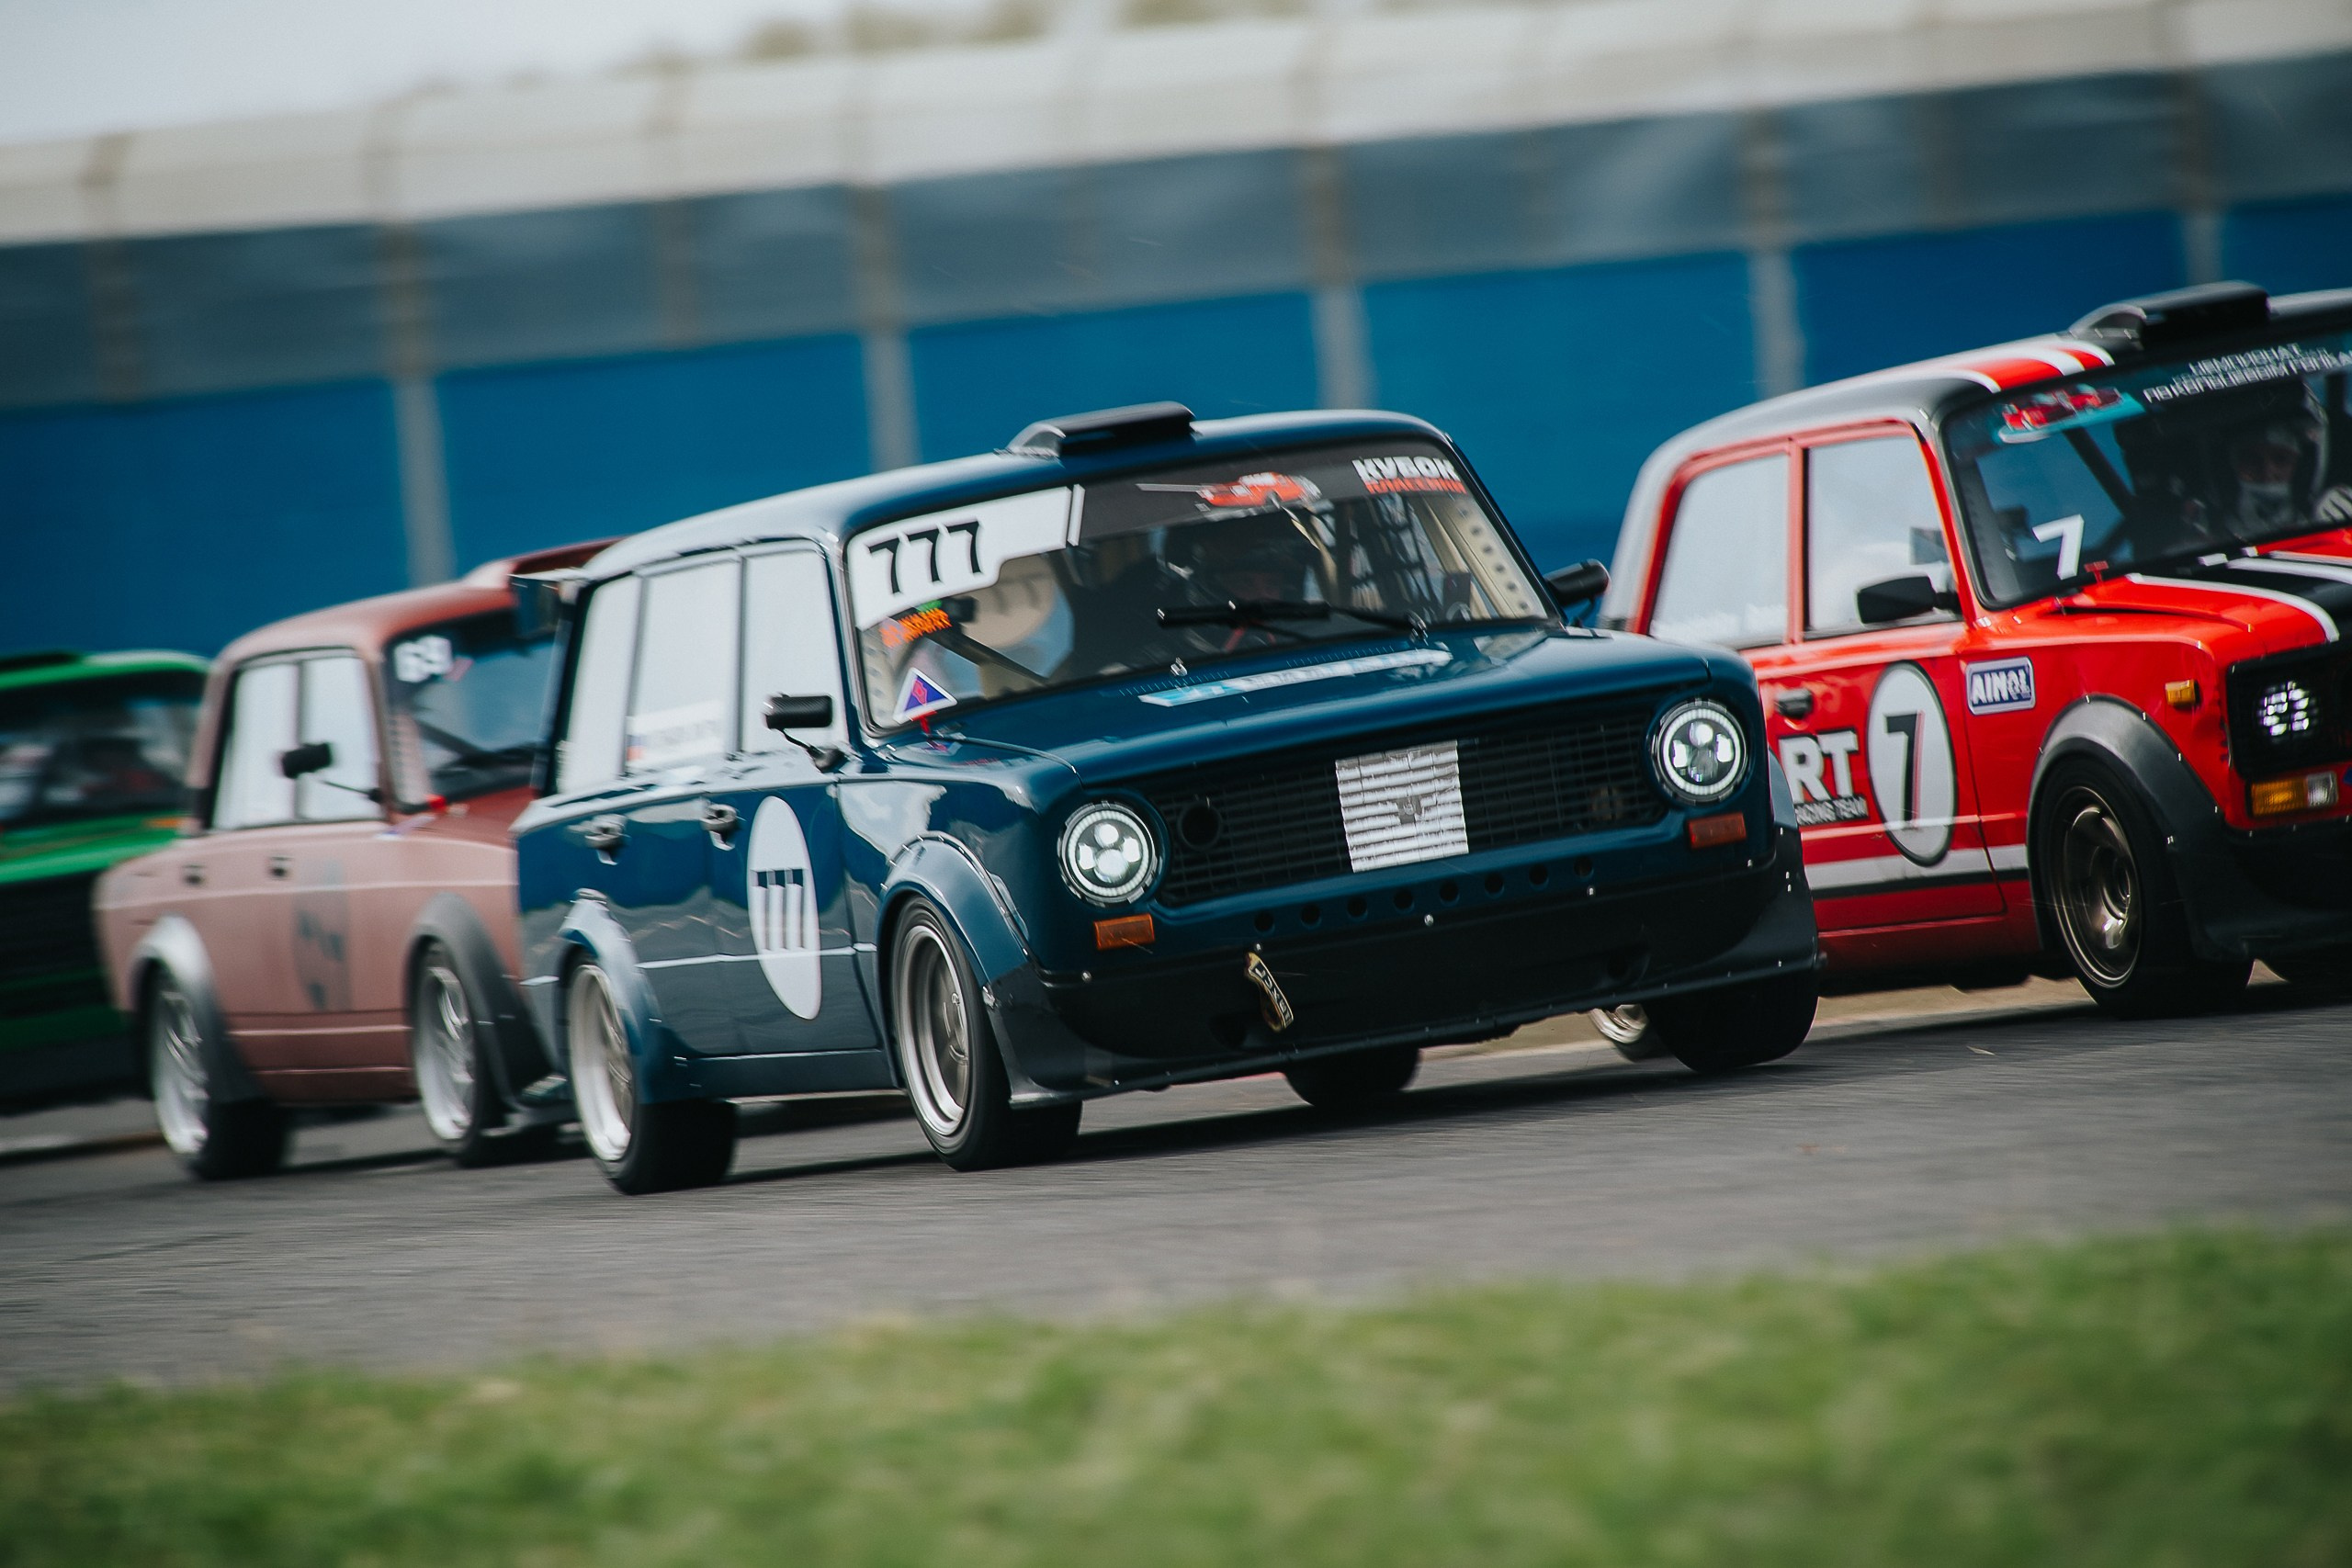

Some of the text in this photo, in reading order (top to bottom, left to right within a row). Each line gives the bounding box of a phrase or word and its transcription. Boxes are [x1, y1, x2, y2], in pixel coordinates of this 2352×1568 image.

[868, 520, 982, 595] 777
[2031, 513, 2084, 581] 7
[1778, 729, 1859, 804] RT
[1885, 710, 1924, 829] 7
